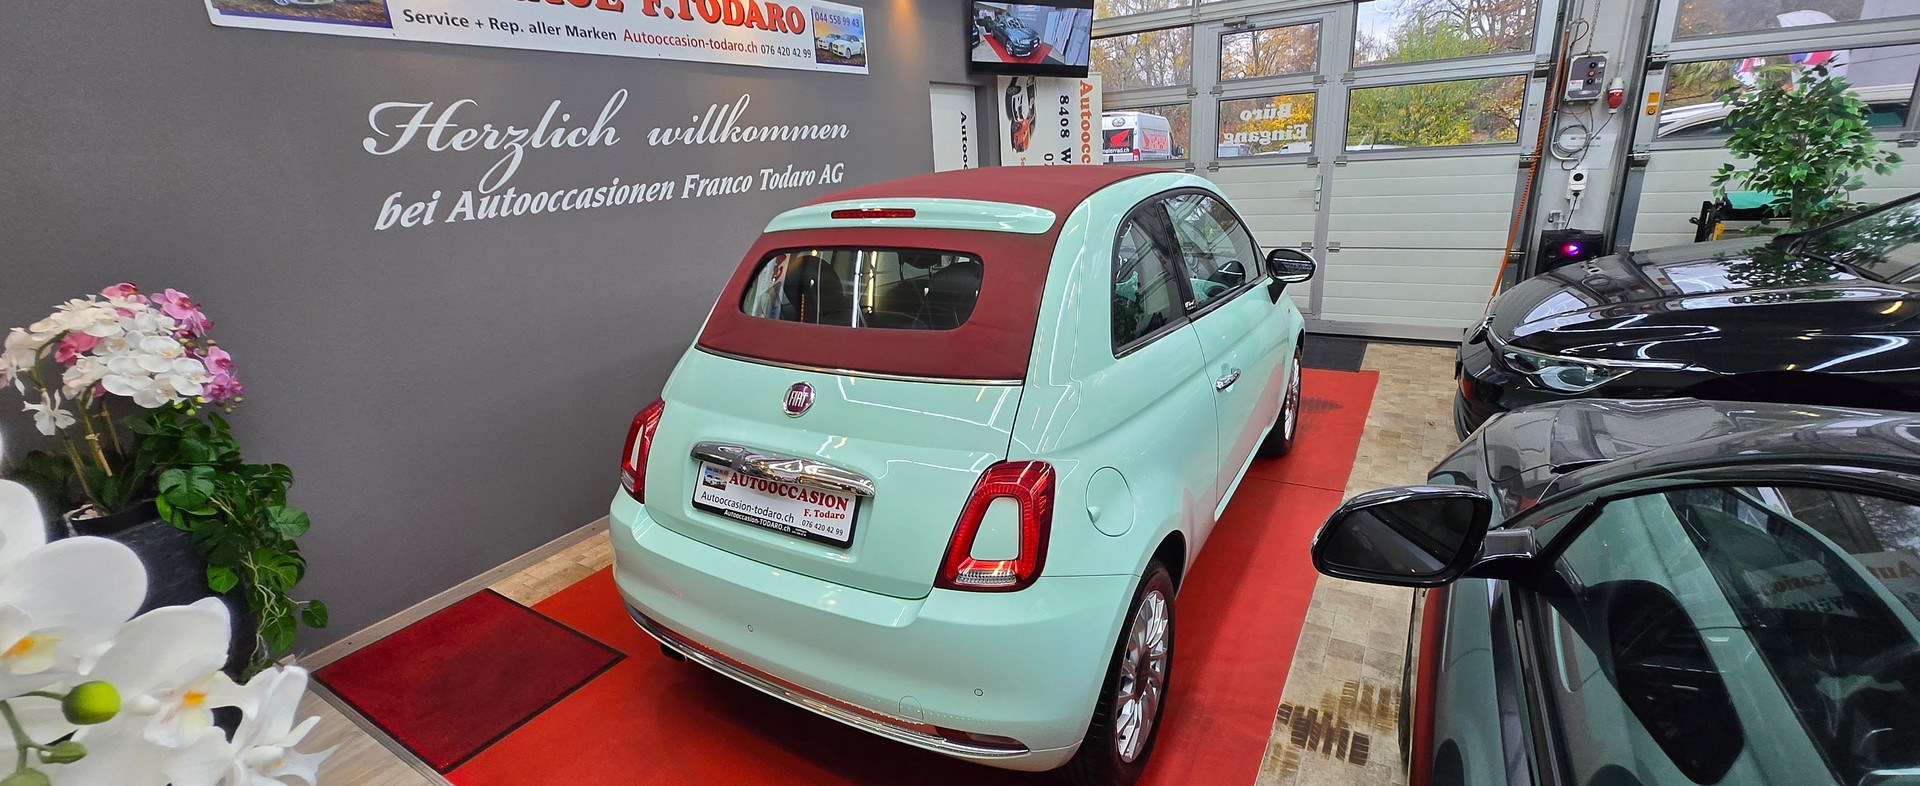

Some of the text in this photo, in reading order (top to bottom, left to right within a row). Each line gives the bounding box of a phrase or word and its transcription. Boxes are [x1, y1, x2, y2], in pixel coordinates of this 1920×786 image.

[402, 9, 617, 41] Service + Rep. aller Marken
[815, 11, 828, 23] 044
[623, 29, 812, 59] Autooccasion-todaro.ch 076 420 42 99
[1059, 95, 1070, 139] 8408
[363, 89, 850, 194] Herzlich willkommen
[373, 162, 845, 231] bei Autooccasionen Franco Todaro AG
[788, 390, 809, 408] FIAT
[701, 491, 795, 523] Autooccasion-todaro.ch
[728, 471, 850, 512] AUTOOCCASION
[724, 509, 791, 533] Autooccasion-TODARO.ch
[801, 519, 813, 528] 076
[814, 522, 826, 532] 420
[826, 525, 835, 534] 42
[835, 528, 844, 536] 99
[803, 508, 845, 520] F. Todaro
